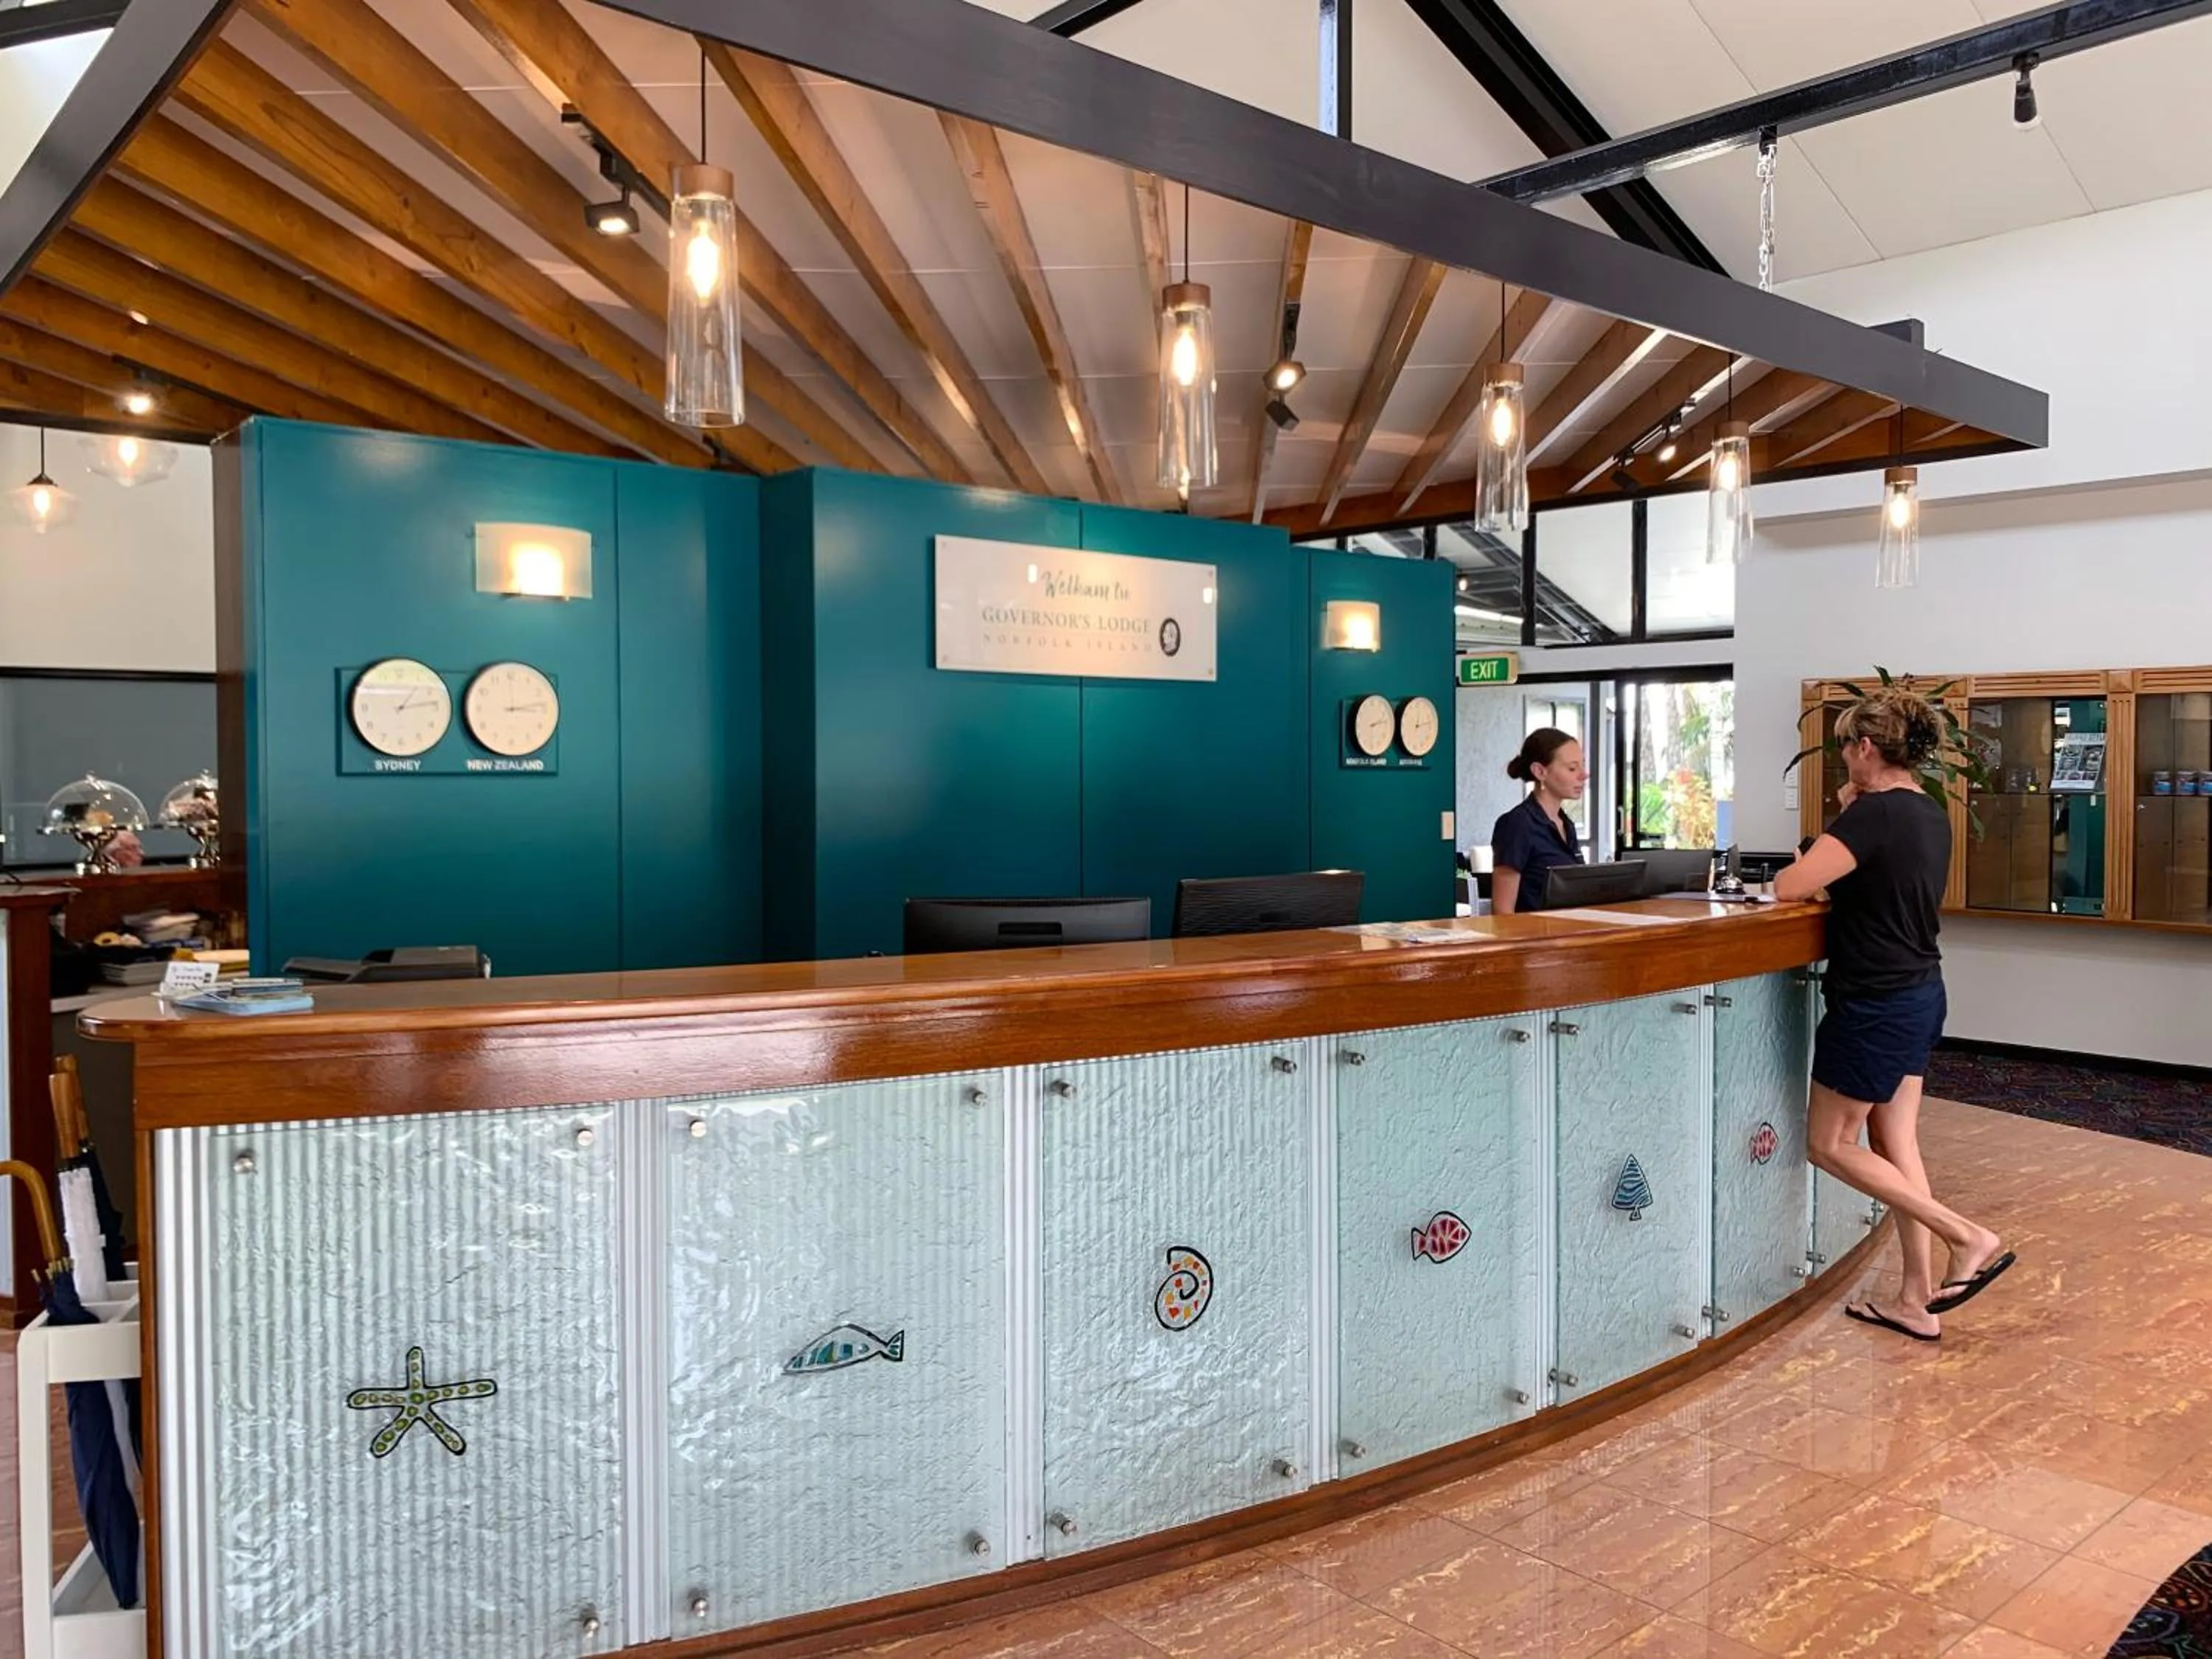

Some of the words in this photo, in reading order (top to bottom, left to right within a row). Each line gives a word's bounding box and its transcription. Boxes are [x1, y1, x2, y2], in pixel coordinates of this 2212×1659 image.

[981, 606, 1091, 630] GOVERNOR'S
[1099, 615, 1150, 633] LODGE
[983, 633, 1073, 648] NORFOLK
[1087, 639, 1152, 652] ISLAND
[1470, 660, 1499, 679] EXIT
[375, 759, 421, 771] SYDNEY
[467, 759, 493, 771] NEW
[494, 759, 544, 771] ZEALAND
